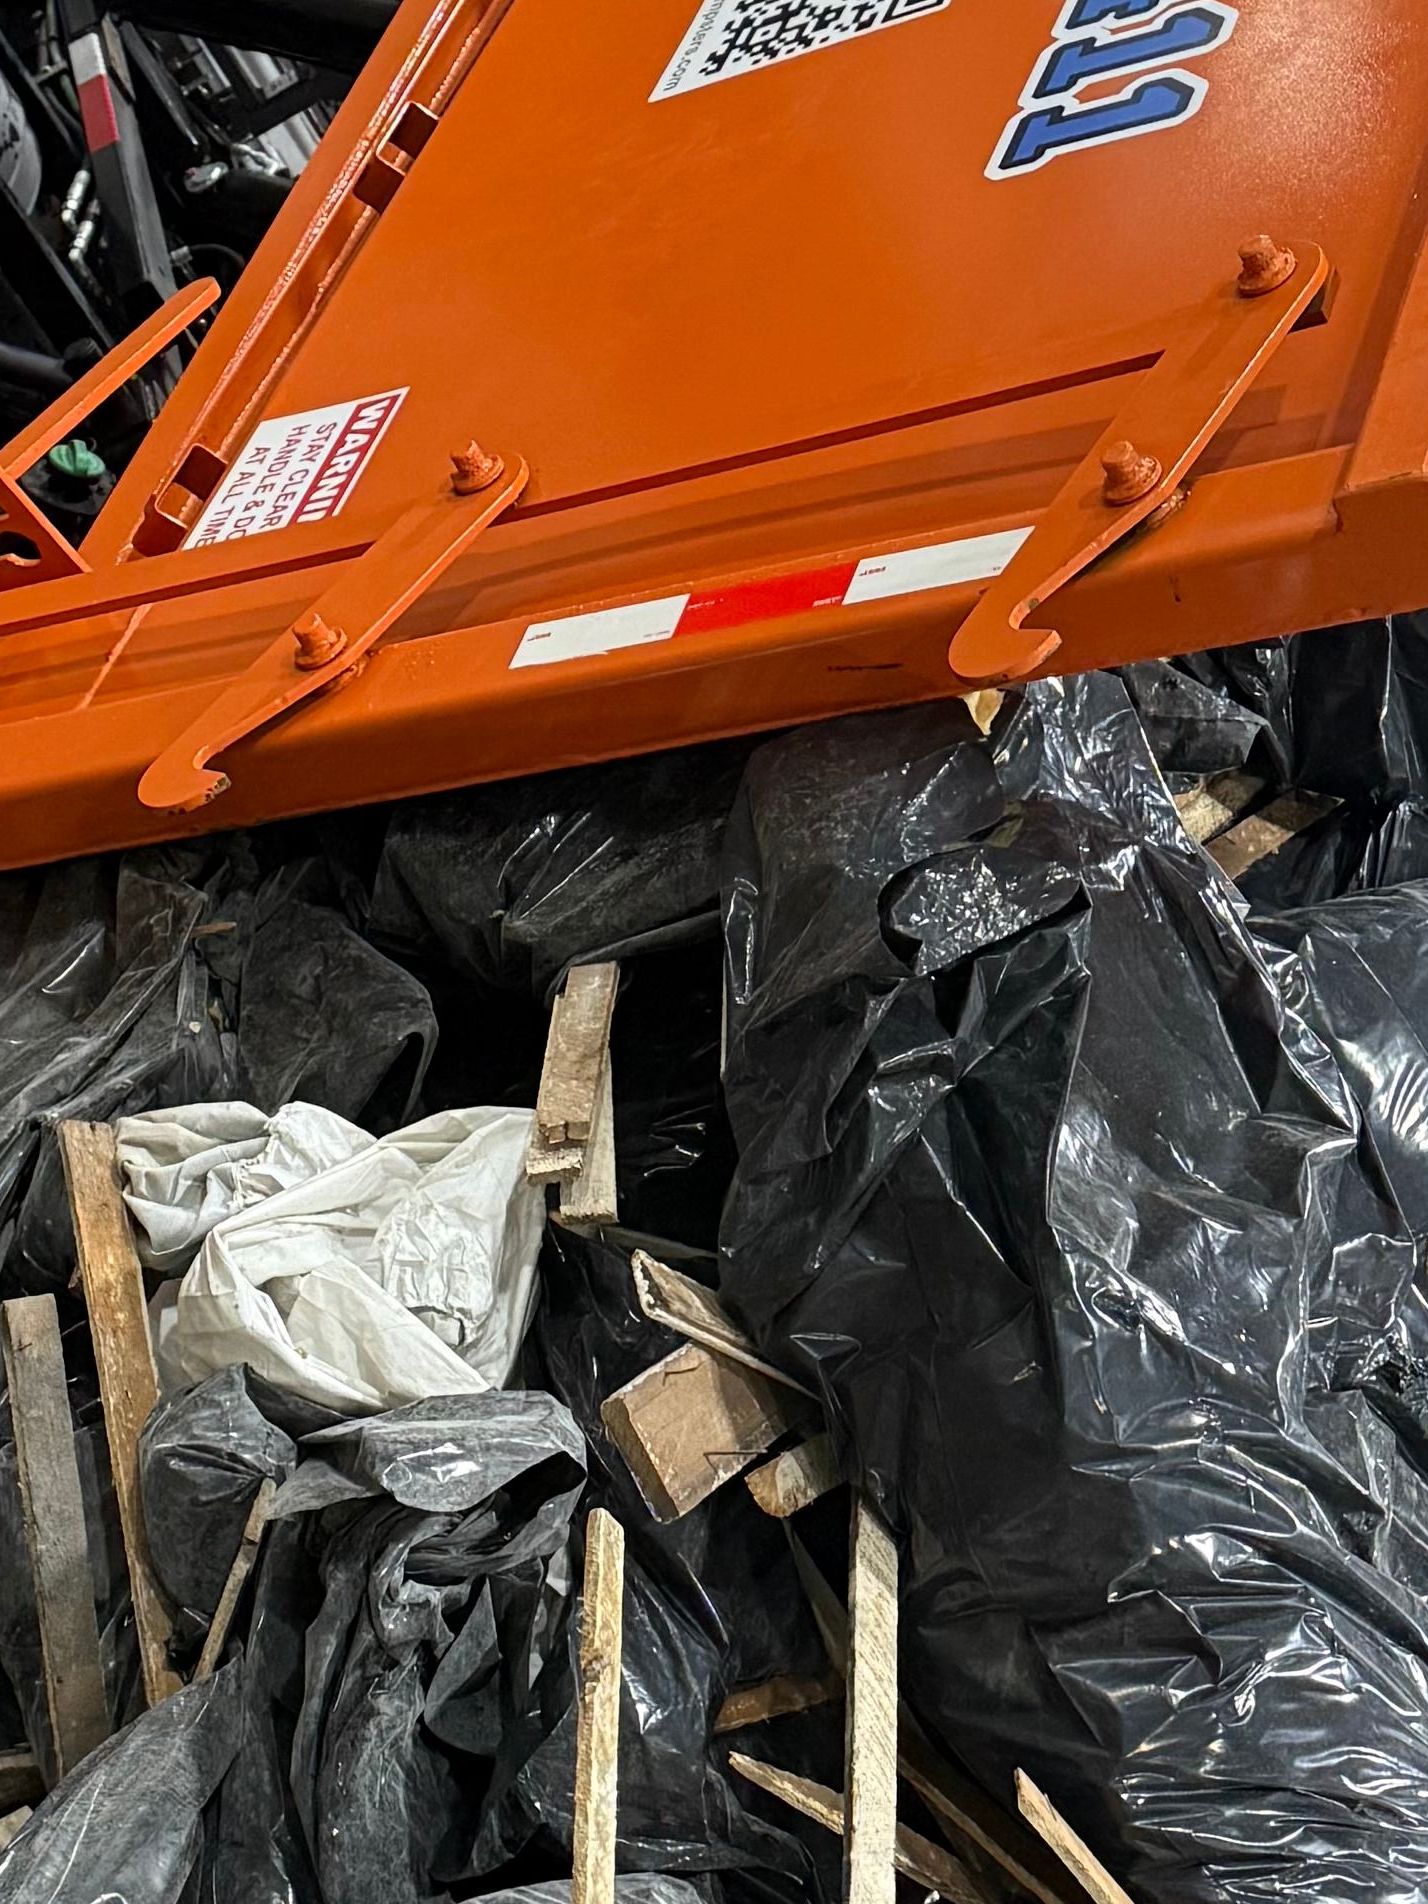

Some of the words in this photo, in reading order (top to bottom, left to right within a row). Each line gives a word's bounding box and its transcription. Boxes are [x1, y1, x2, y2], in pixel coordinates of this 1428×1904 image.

[245, 447, 267, 465] AT
[252, 424, 311, 496] HANDLE
[301, 421, 338, 463] STAY
[221, 471, 253, 505] ALL
[242, 500, 265, 512] &
[259, 468, 309, 529] CLEAR
[195, 506, 235, 546] TIME
[226, 516, 255, 540] DO
